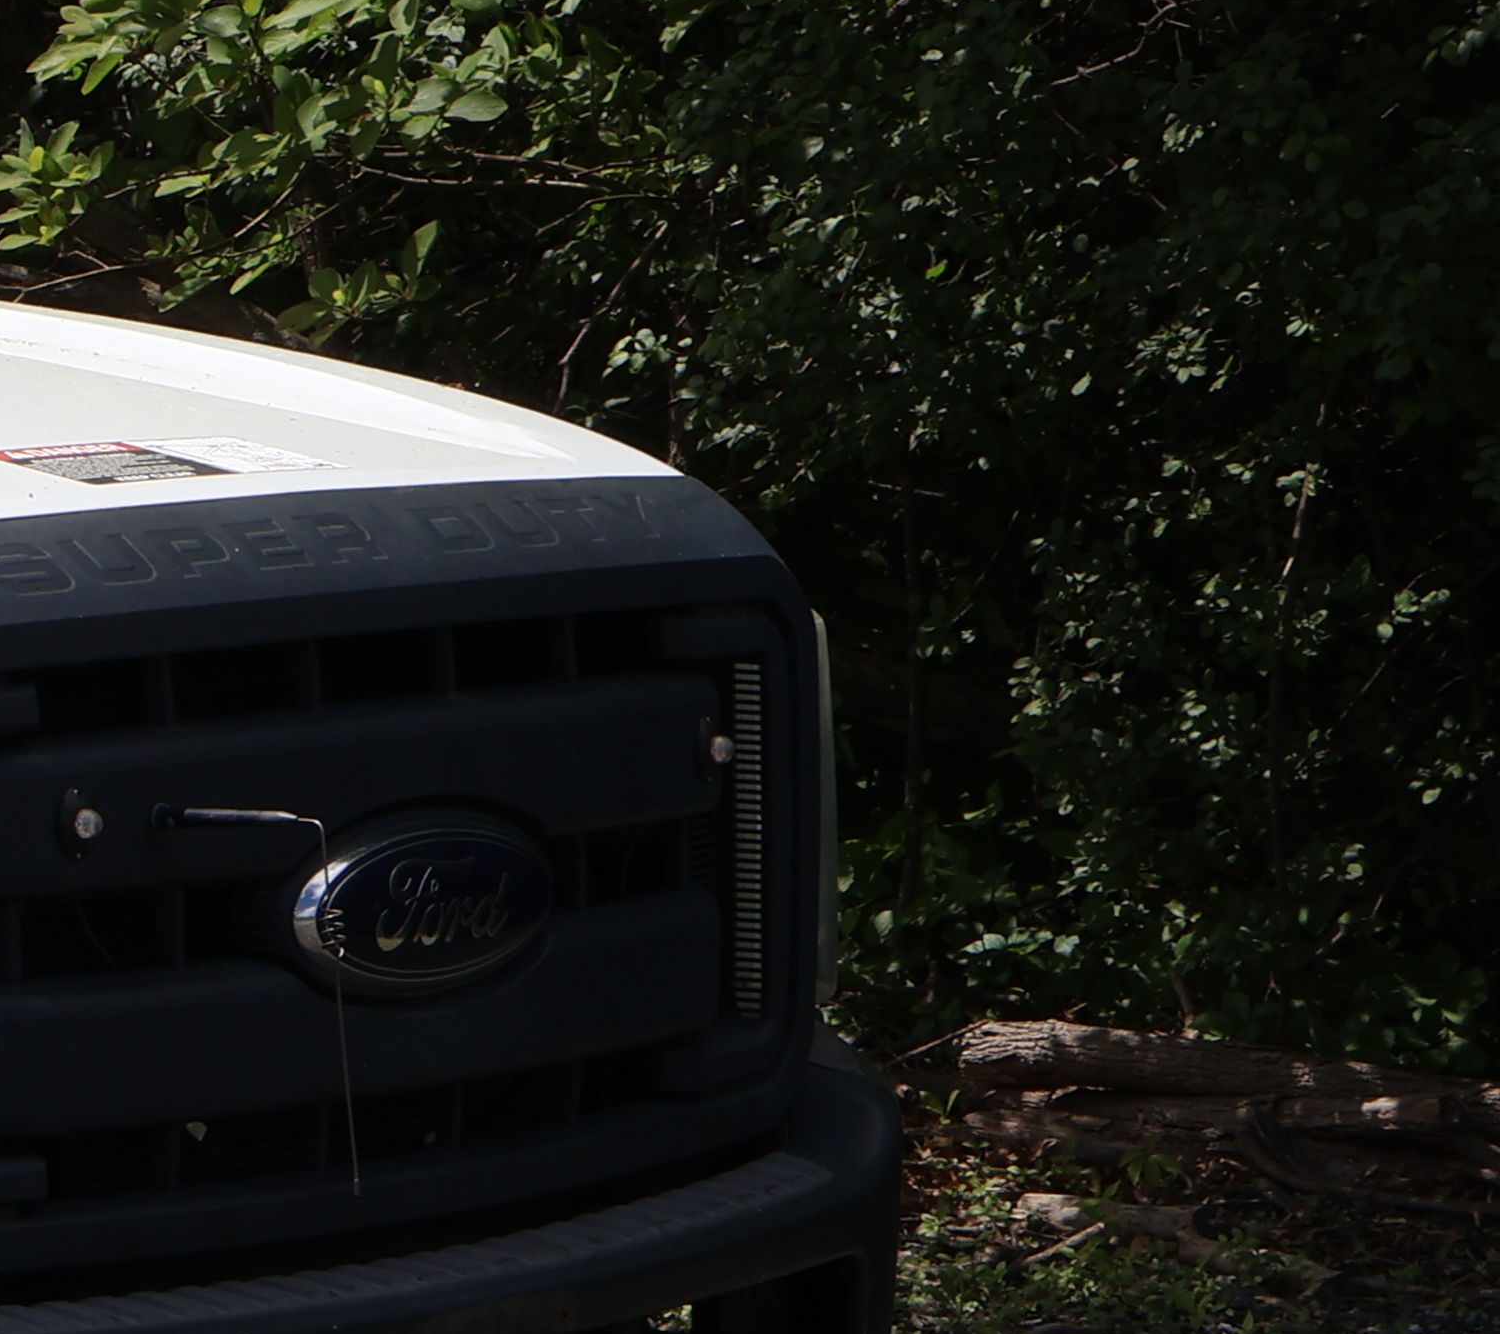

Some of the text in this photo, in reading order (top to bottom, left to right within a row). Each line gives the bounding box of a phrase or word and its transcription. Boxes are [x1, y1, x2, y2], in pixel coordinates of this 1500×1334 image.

[27, 442, 127, 458] DANGER
[409, 492, 663, 556] DUTY
[375, 855, 514, 953] Ford
